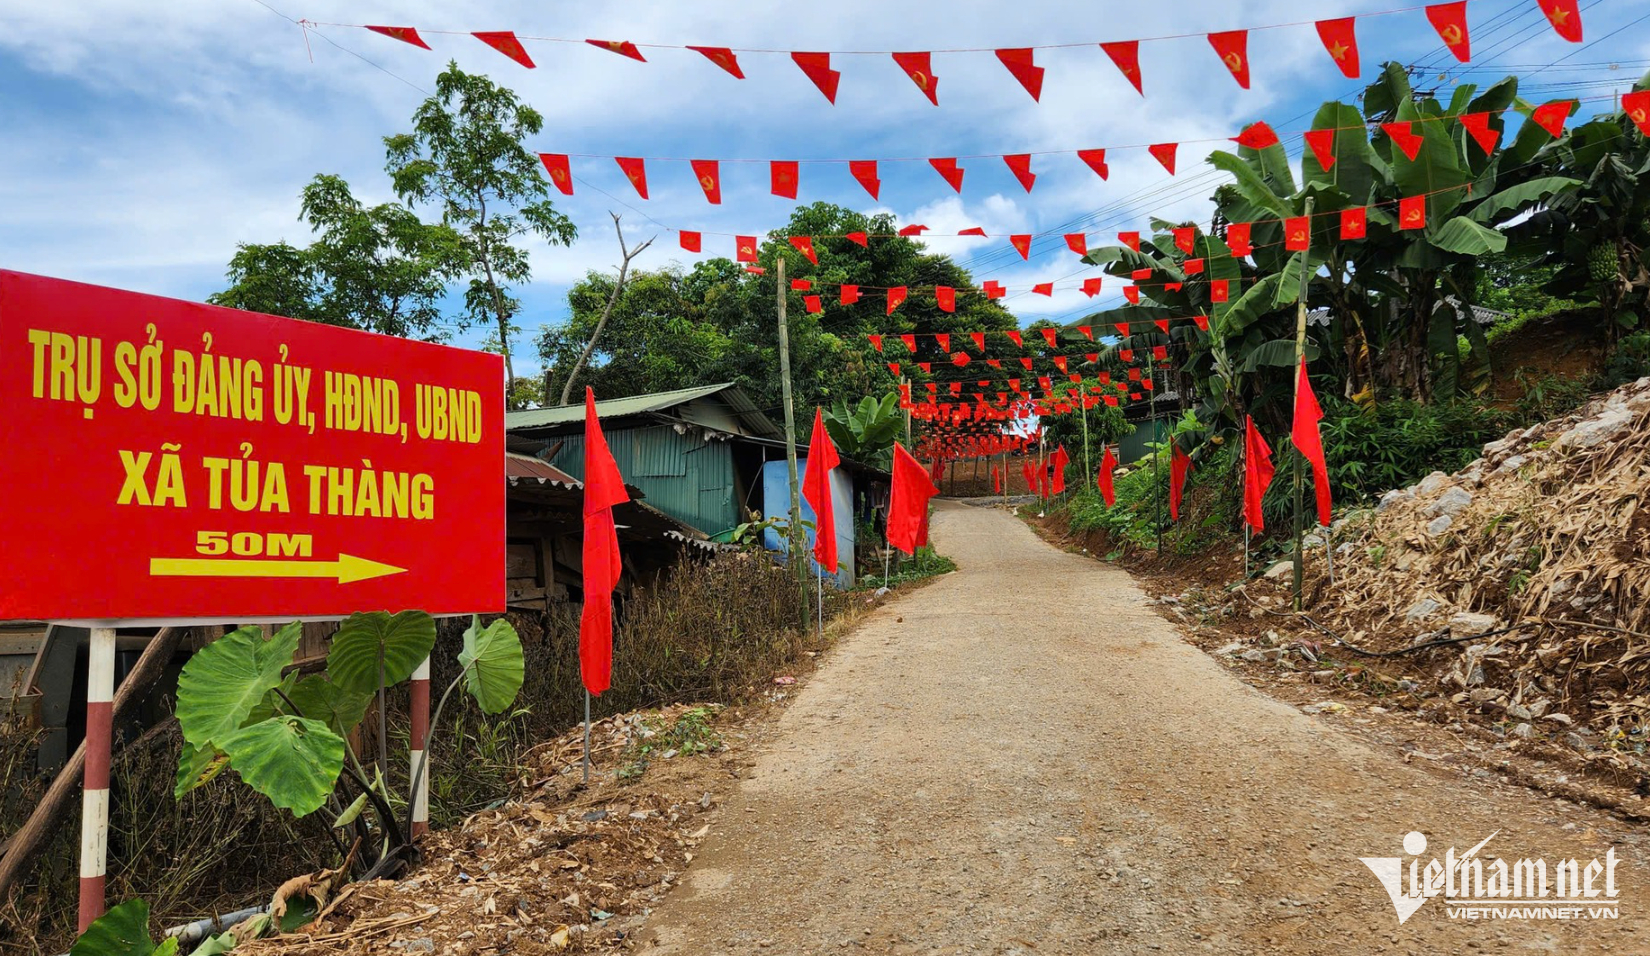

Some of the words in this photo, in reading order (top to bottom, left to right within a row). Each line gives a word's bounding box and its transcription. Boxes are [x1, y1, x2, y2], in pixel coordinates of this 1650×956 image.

[29, 329, 101, 419] TRỤ
[114, 323, 163, 413] SỞ
[173, 332, 262, 421] ĐẢNG
[274, 344, 314, 434] ỦY,
[325, 371, 407, 443] HĐND,
[416, 384, 481, 443] UBND
[117, 442, 187, 507] XÃ
[203, 442, 289, 512] TỦA
[304, 459, 433, 519] THÀNG
[196, 531, 312, 556] 50M
